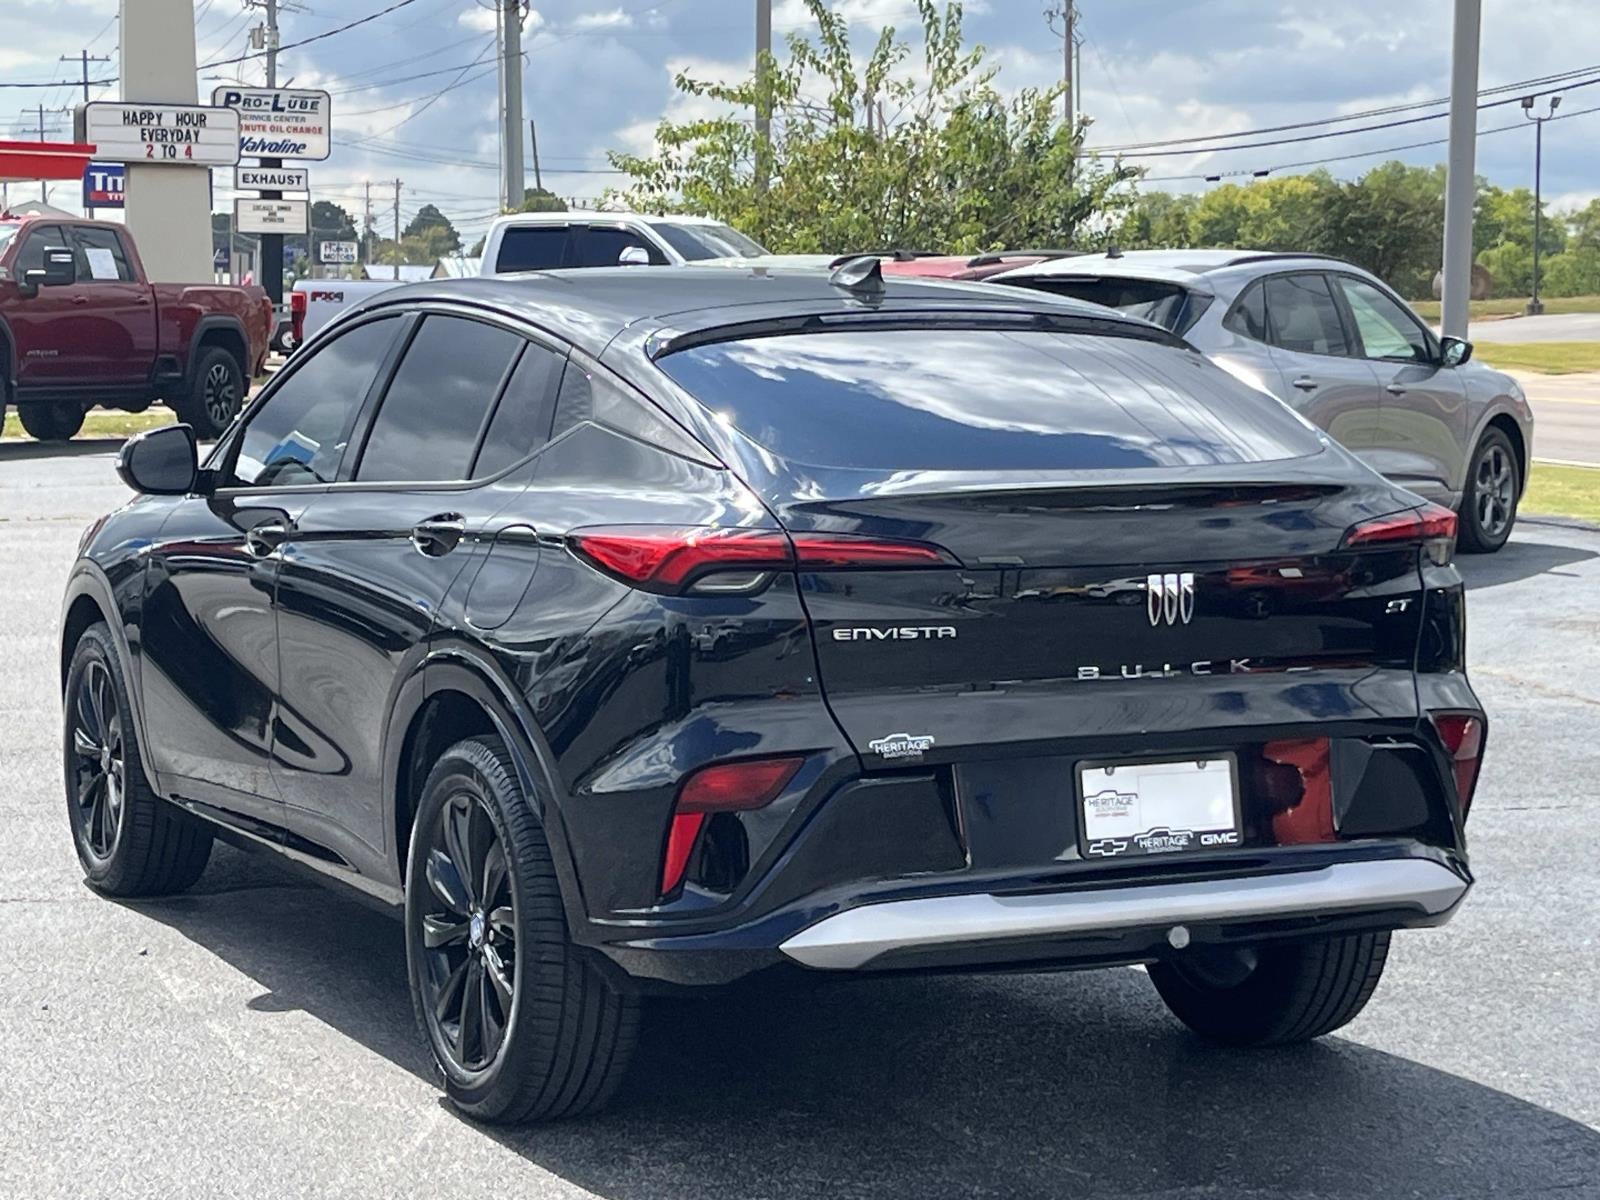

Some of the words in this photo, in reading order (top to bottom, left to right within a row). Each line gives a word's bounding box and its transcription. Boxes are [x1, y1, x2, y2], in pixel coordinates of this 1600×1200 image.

[223, 91, 320, 112] PRO-LUBE
[122, 111, 163, 126] HAPPY
[176, 112, 207, 127] HOUR
[140, 128, 200, 143] EVERYDAY
[269, 125, 284, 133] OIL
[286, 125, 323, 134] CHANGE
[146, 144, 154, 159] 2
[184, 145, 193, 160] 4
[240, 136, 307, 154] Valvoline
[242, 173, 302, 185] EXHAUST
[311, 291, 344, 302] FX4
[832, 626, 957, 641] ENVISTA
[1078, 658, 1251, 680] BUICK
[874, 740, 930, 754] HERITAGE
[1088, 797, 1133, 807] HERITAGE
[1139, 835, 1189, 848] HERITAGE
[1200, 832, 1238, 845] GMC
